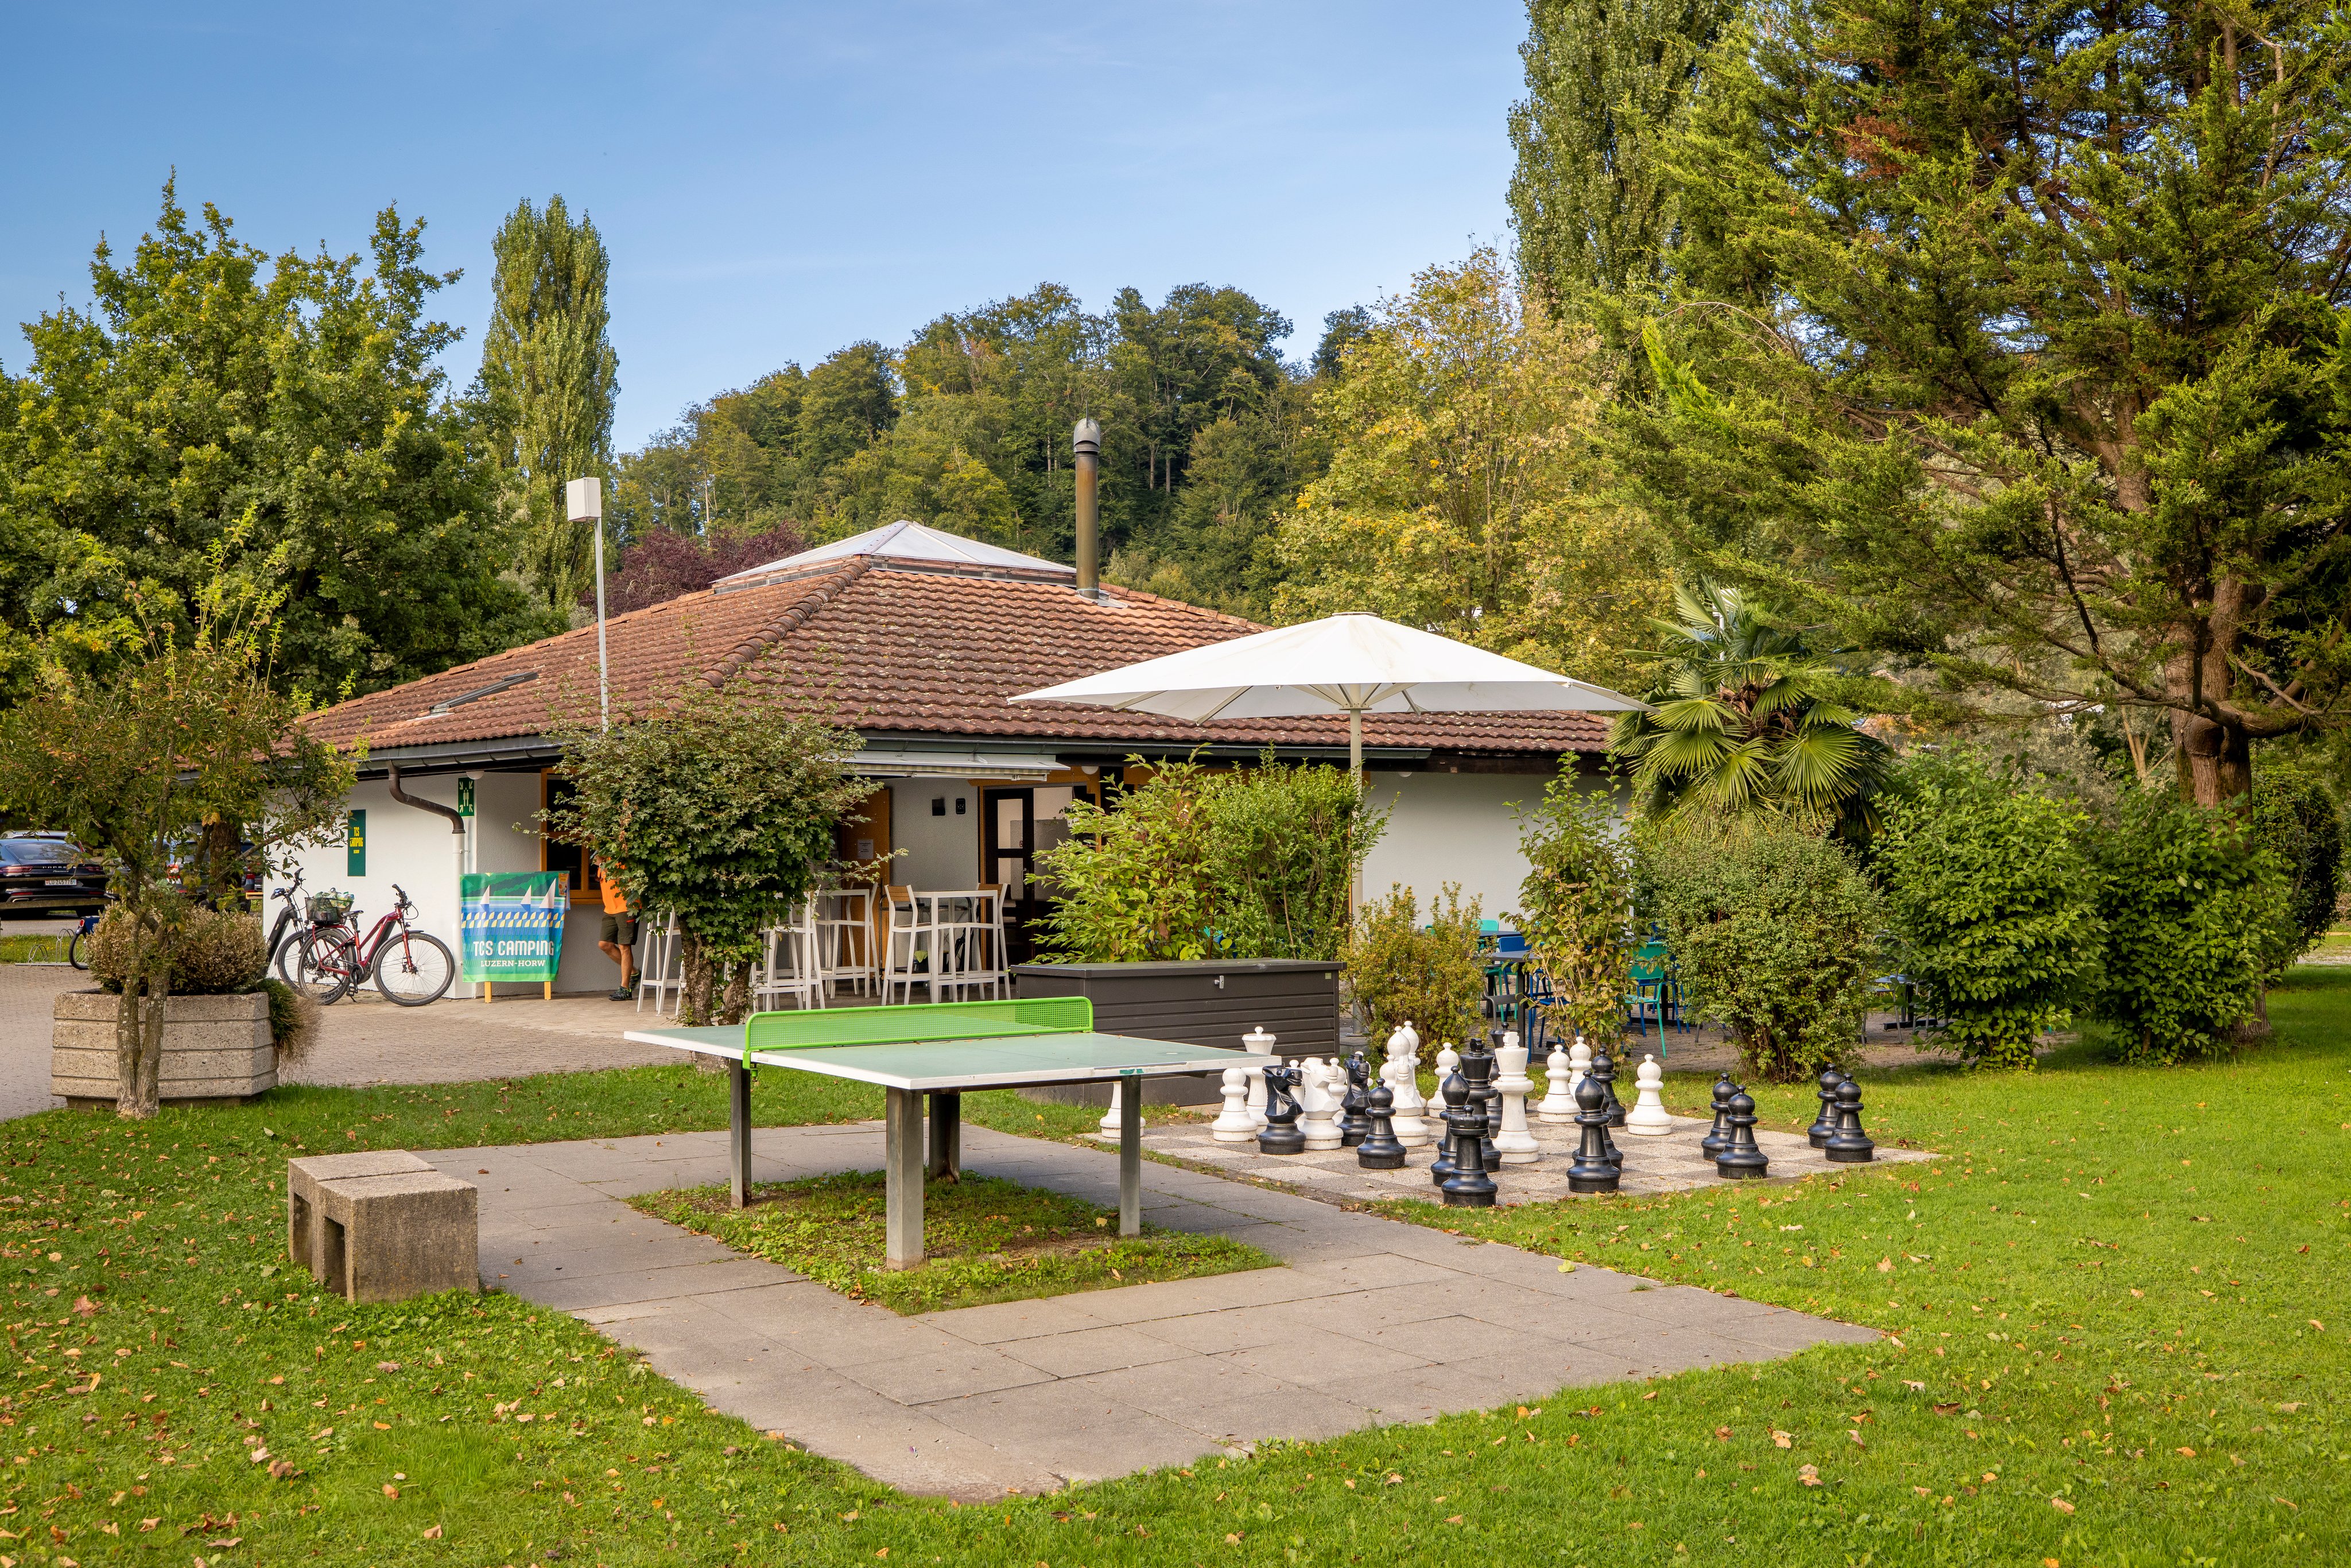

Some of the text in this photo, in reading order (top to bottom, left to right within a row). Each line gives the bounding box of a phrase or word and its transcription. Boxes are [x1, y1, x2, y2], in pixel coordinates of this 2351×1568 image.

[350, 837, 363, 847] CAMPING
[473, 940, 554, 956] TCS CAMPING
